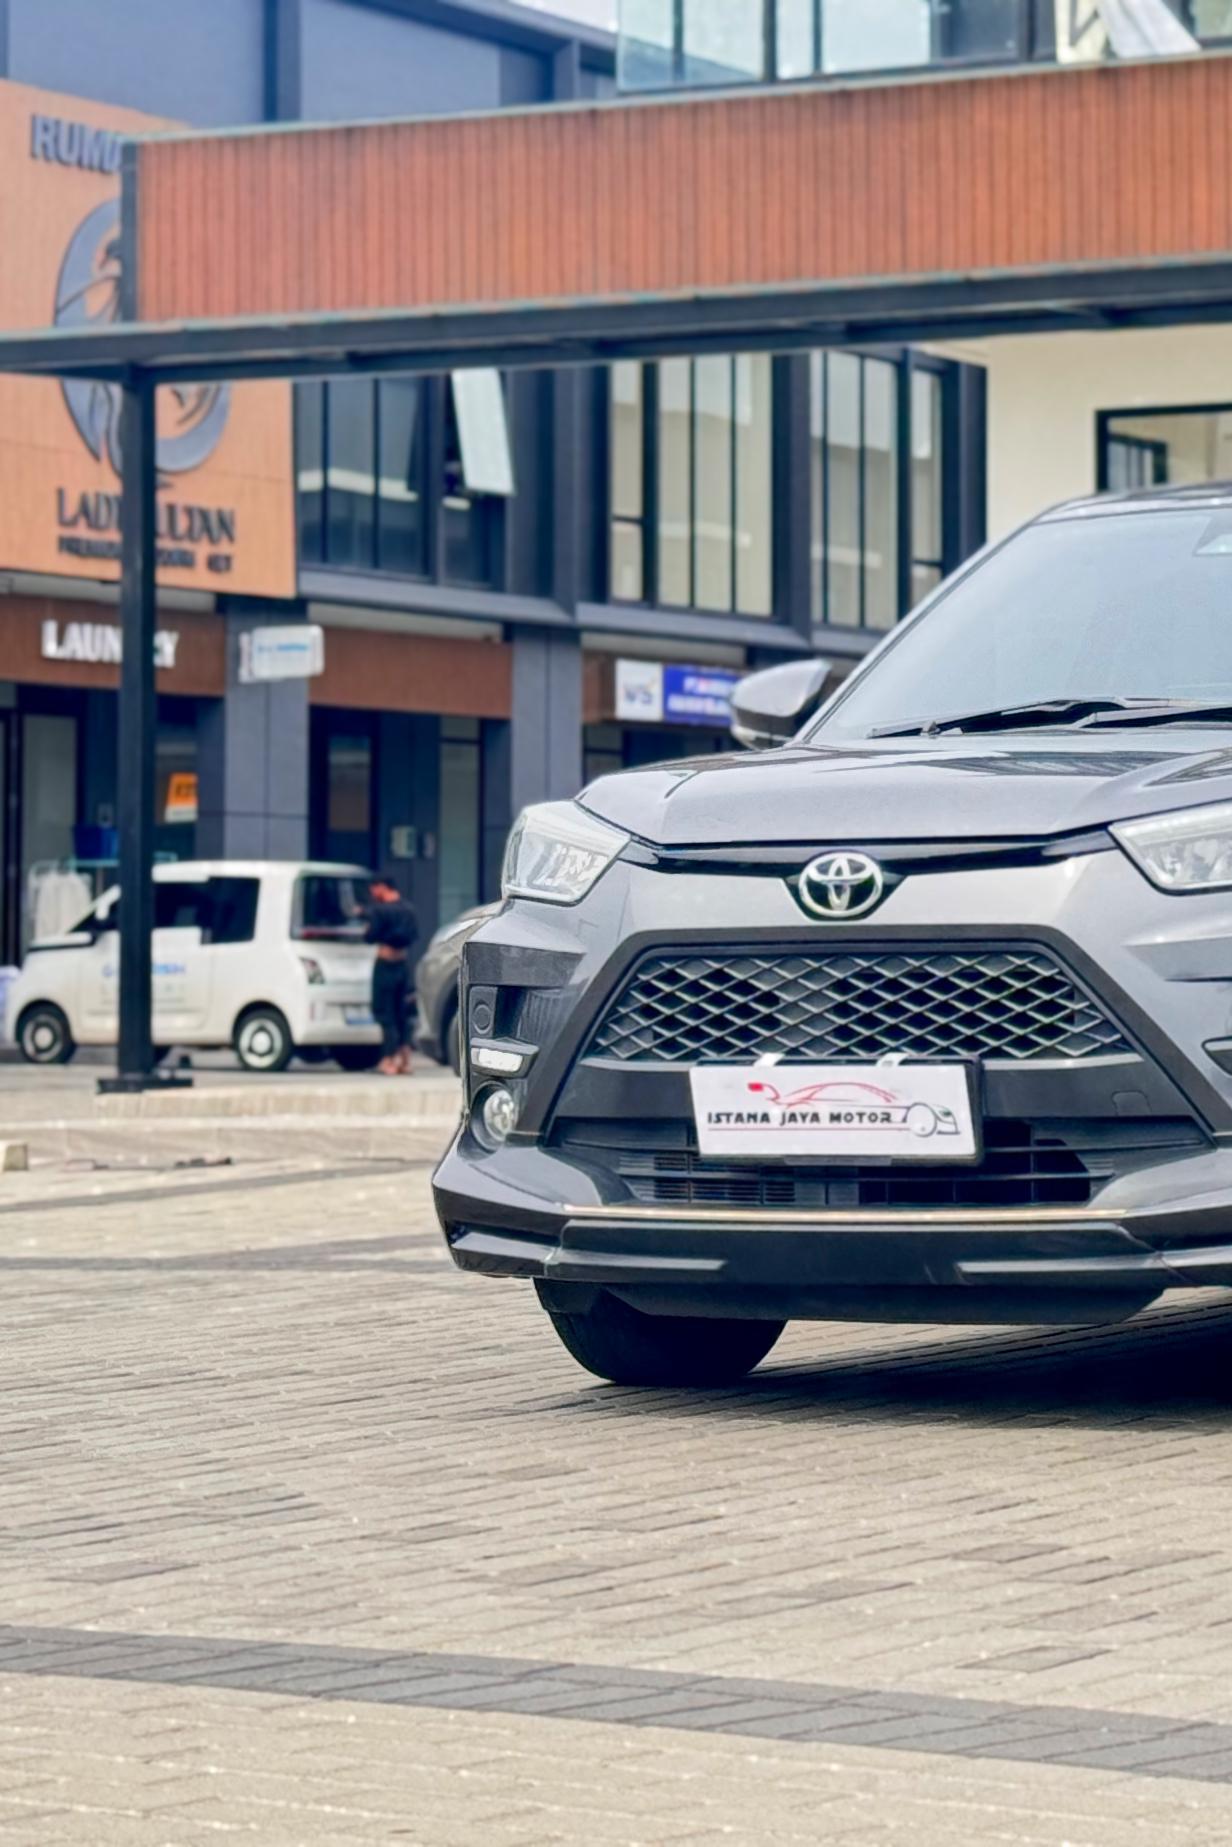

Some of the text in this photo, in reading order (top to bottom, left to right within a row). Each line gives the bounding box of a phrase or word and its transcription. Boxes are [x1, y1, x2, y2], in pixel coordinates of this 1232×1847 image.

[30, 114, 122, 175] RUM
[57, 487, 122, 531] LAD
[41, 619, 179, 668] LAUNY
[707, 1111, 892, 1126] ISTANA JAYA MOTOR
